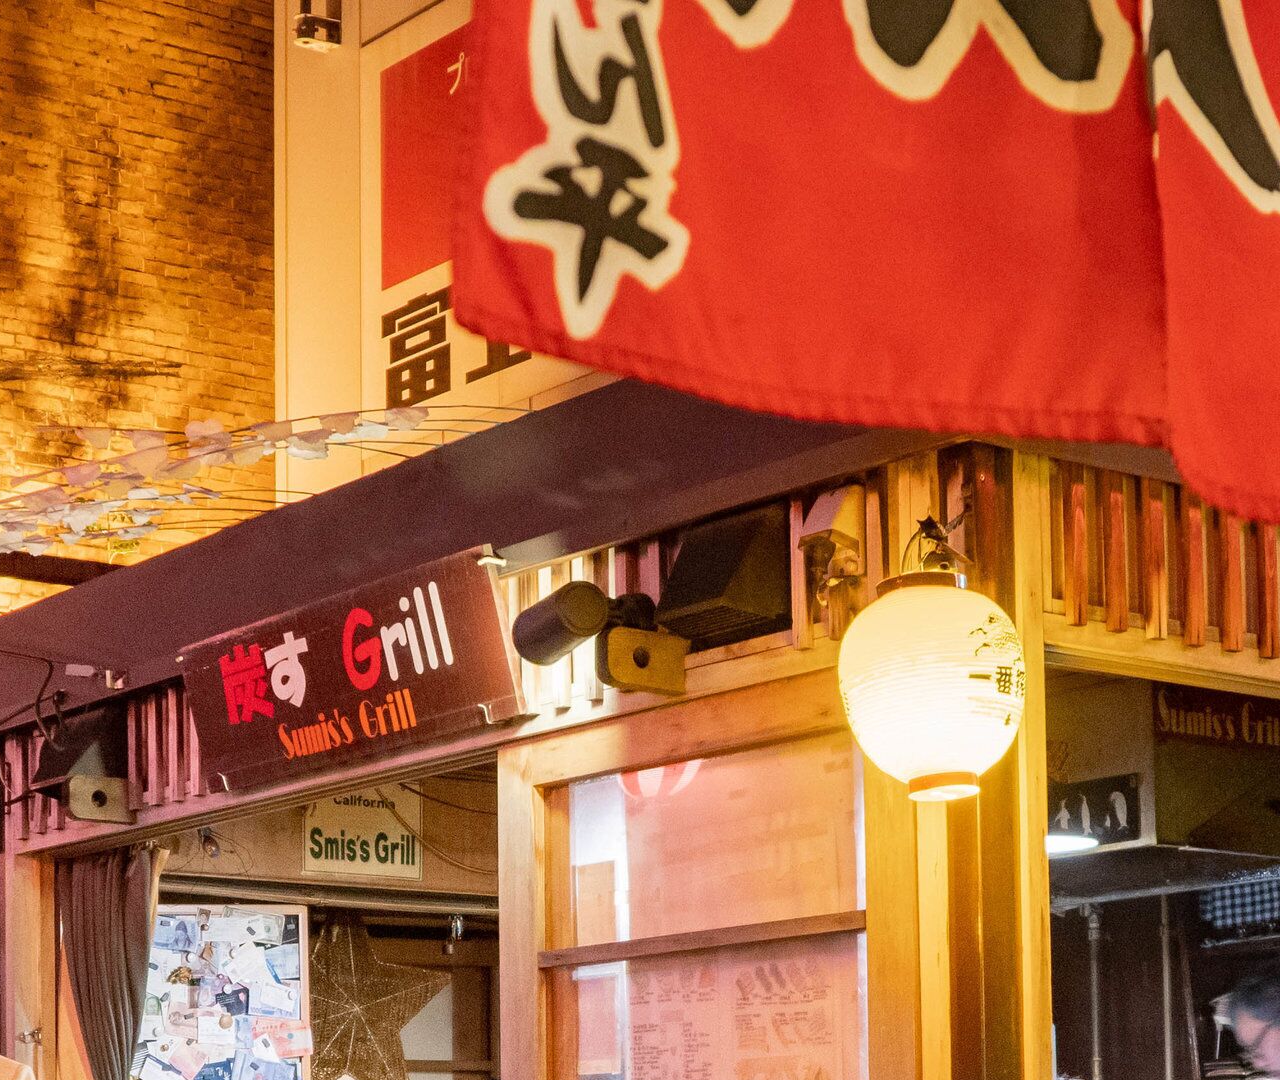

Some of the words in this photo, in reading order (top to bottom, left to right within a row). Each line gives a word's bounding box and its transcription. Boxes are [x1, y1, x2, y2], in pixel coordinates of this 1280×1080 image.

[218, 631, 309, 725] 炭す
[342, 581, 454, 691] Grill
[277, 708, 354, 760] Sumis's
[358, 688, 417, 738] Grill
[1158, 689, 1236, 741] Sumis's
[333, 795, 397, 810] California
[309, 827, 371, 863] Smis's
[374, 831, 416, 866] Grill
